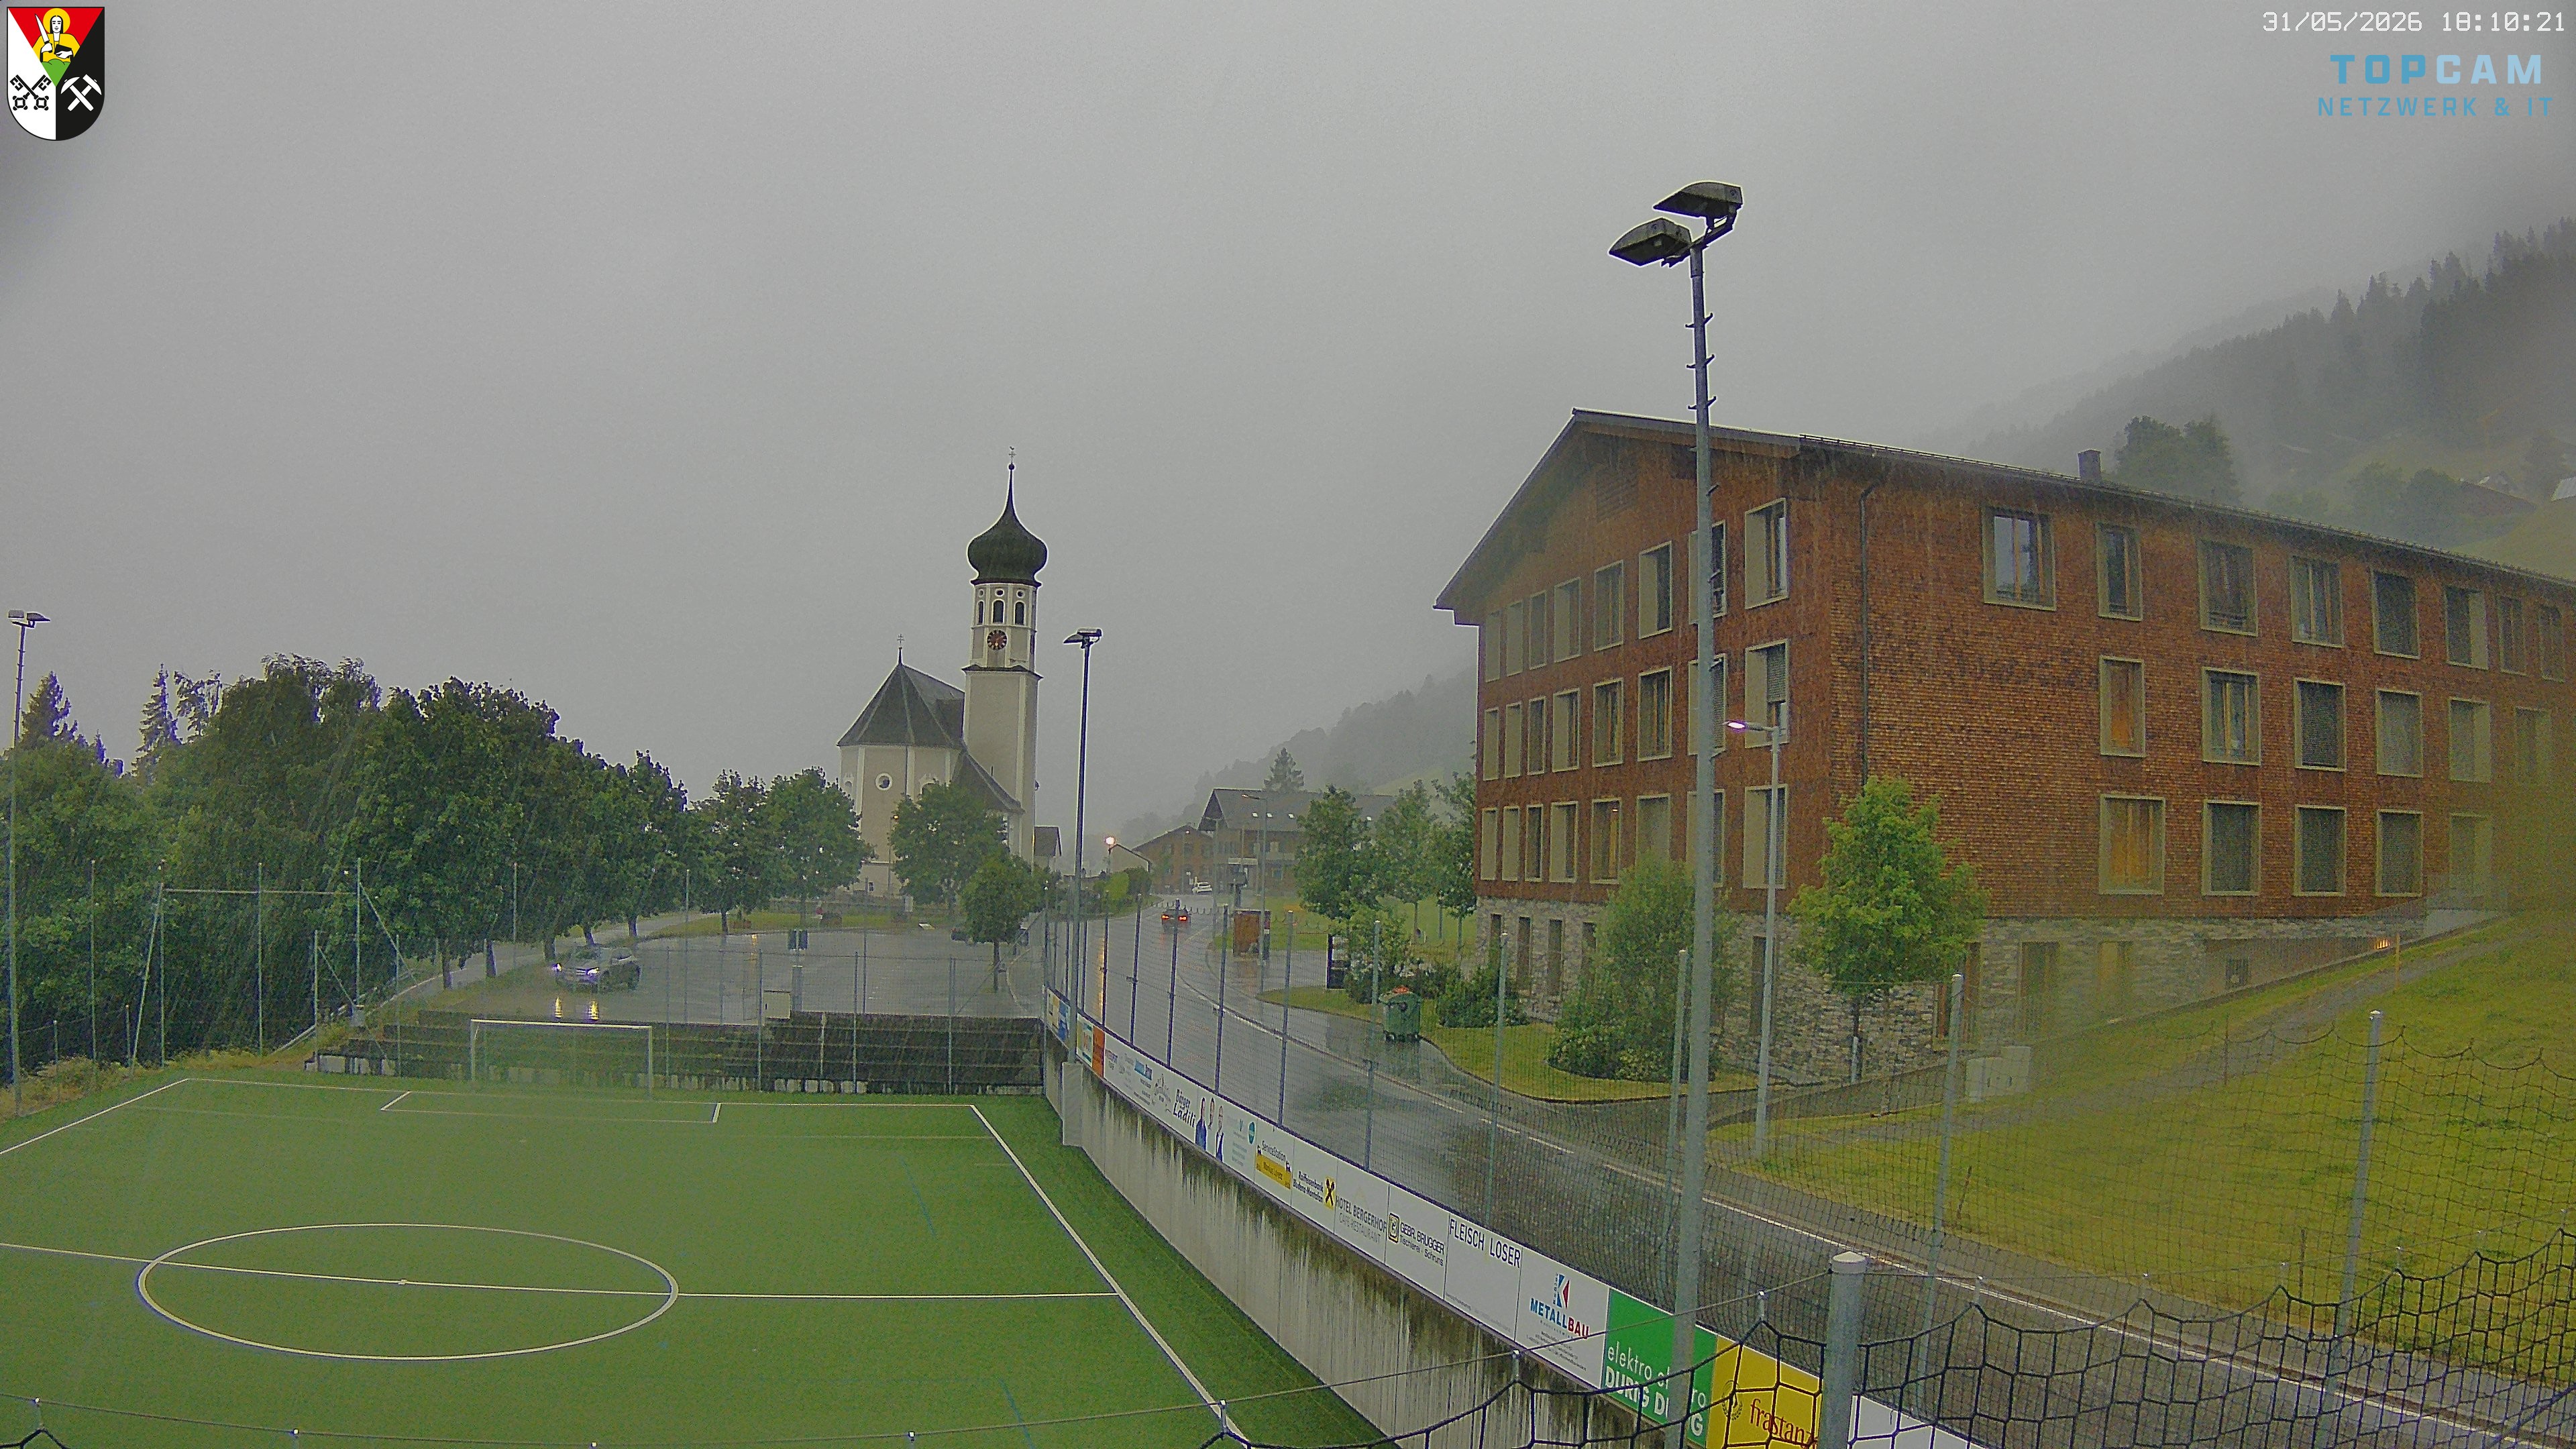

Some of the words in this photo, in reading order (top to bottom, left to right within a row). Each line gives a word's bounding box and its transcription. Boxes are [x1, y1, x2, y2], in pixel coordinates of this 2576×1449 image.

[1336, 1195, 1352, 1214] HOTEL
[1353, 1205, 1387, 1233] BERGERHOF
[1450, 1218, 1485, 1251] FLEISCH
[1490, 1237, 1521, 1269] LOSER
[1530, 1297, 1589, 1340] METALLBAU
[1607, 1340, 1652, 1381] elektro
[1657, 1366, 1707, 1408] elro
